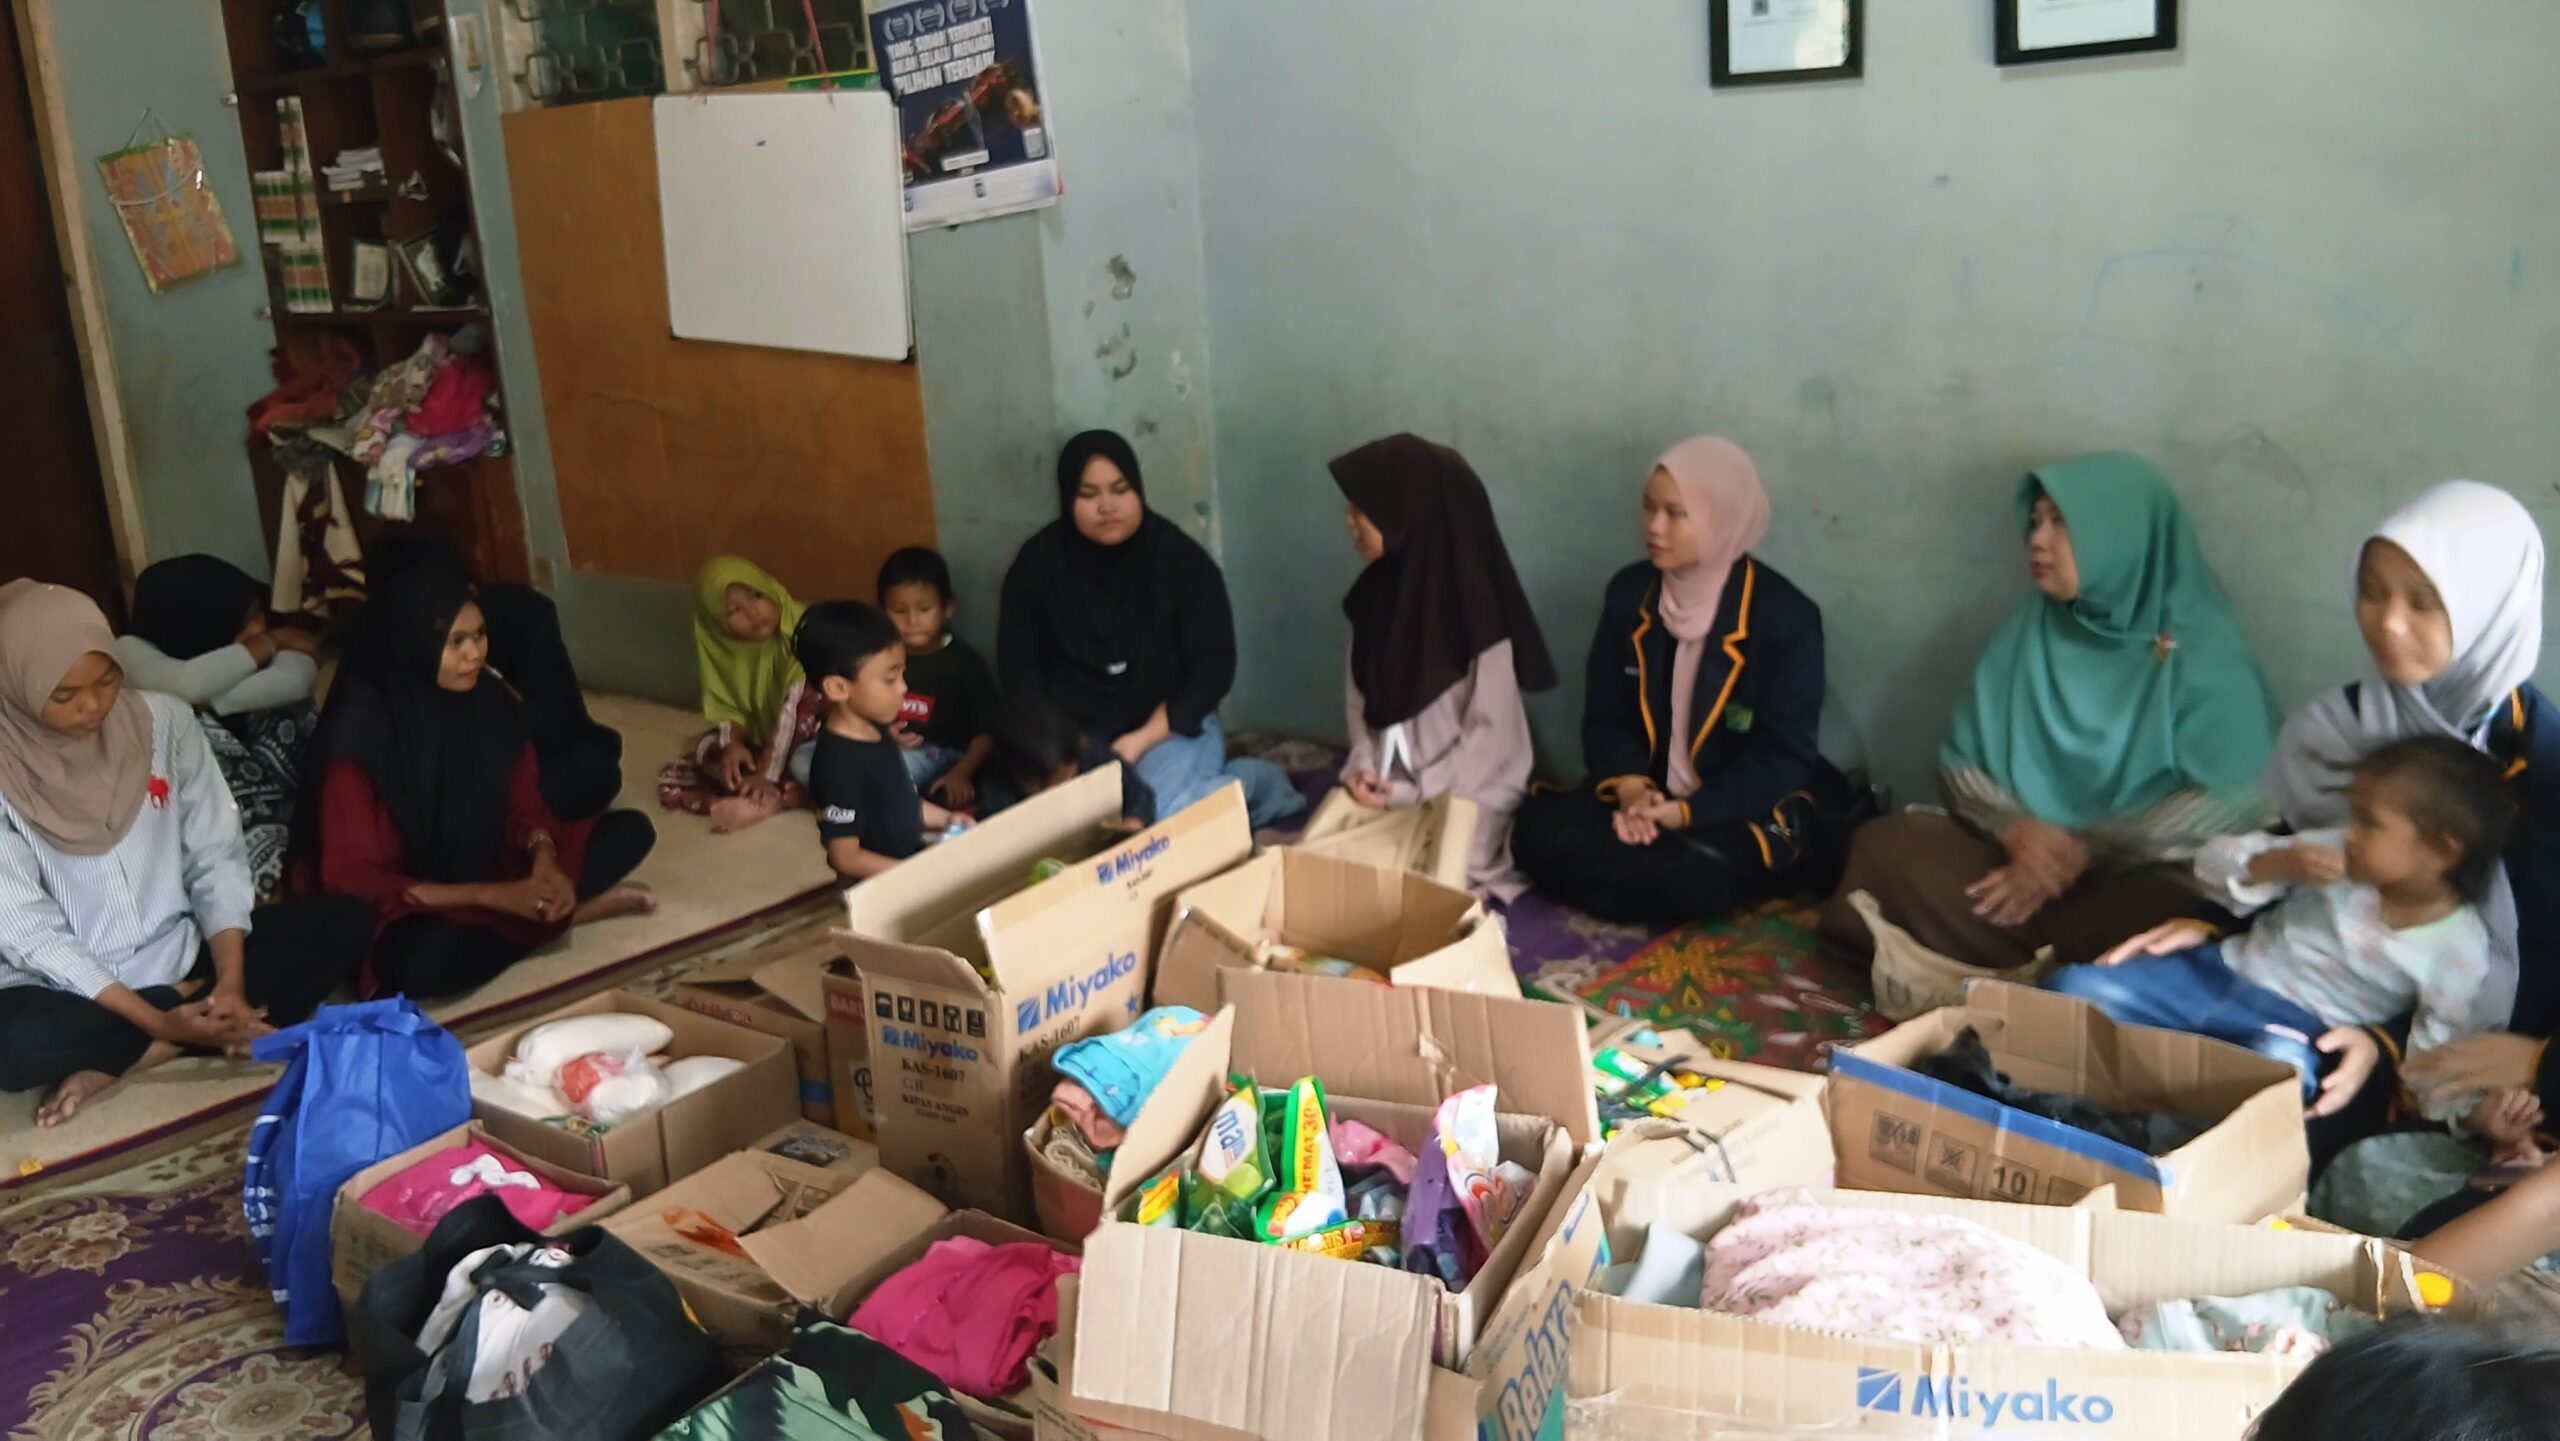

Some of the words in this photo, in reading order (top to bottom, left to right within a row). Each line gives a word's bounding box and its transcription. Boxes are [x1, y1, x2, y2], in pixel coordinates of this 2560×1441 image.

[1115, 835, 1170, 876] Miyako
[1046, 952, 1137, 1020] Miyako
[904, 1030, 979, 1062] Miyako
[1993, 1166, 2027, 1196] 10
[1911, 1377, 2114, 1427] Miyako
